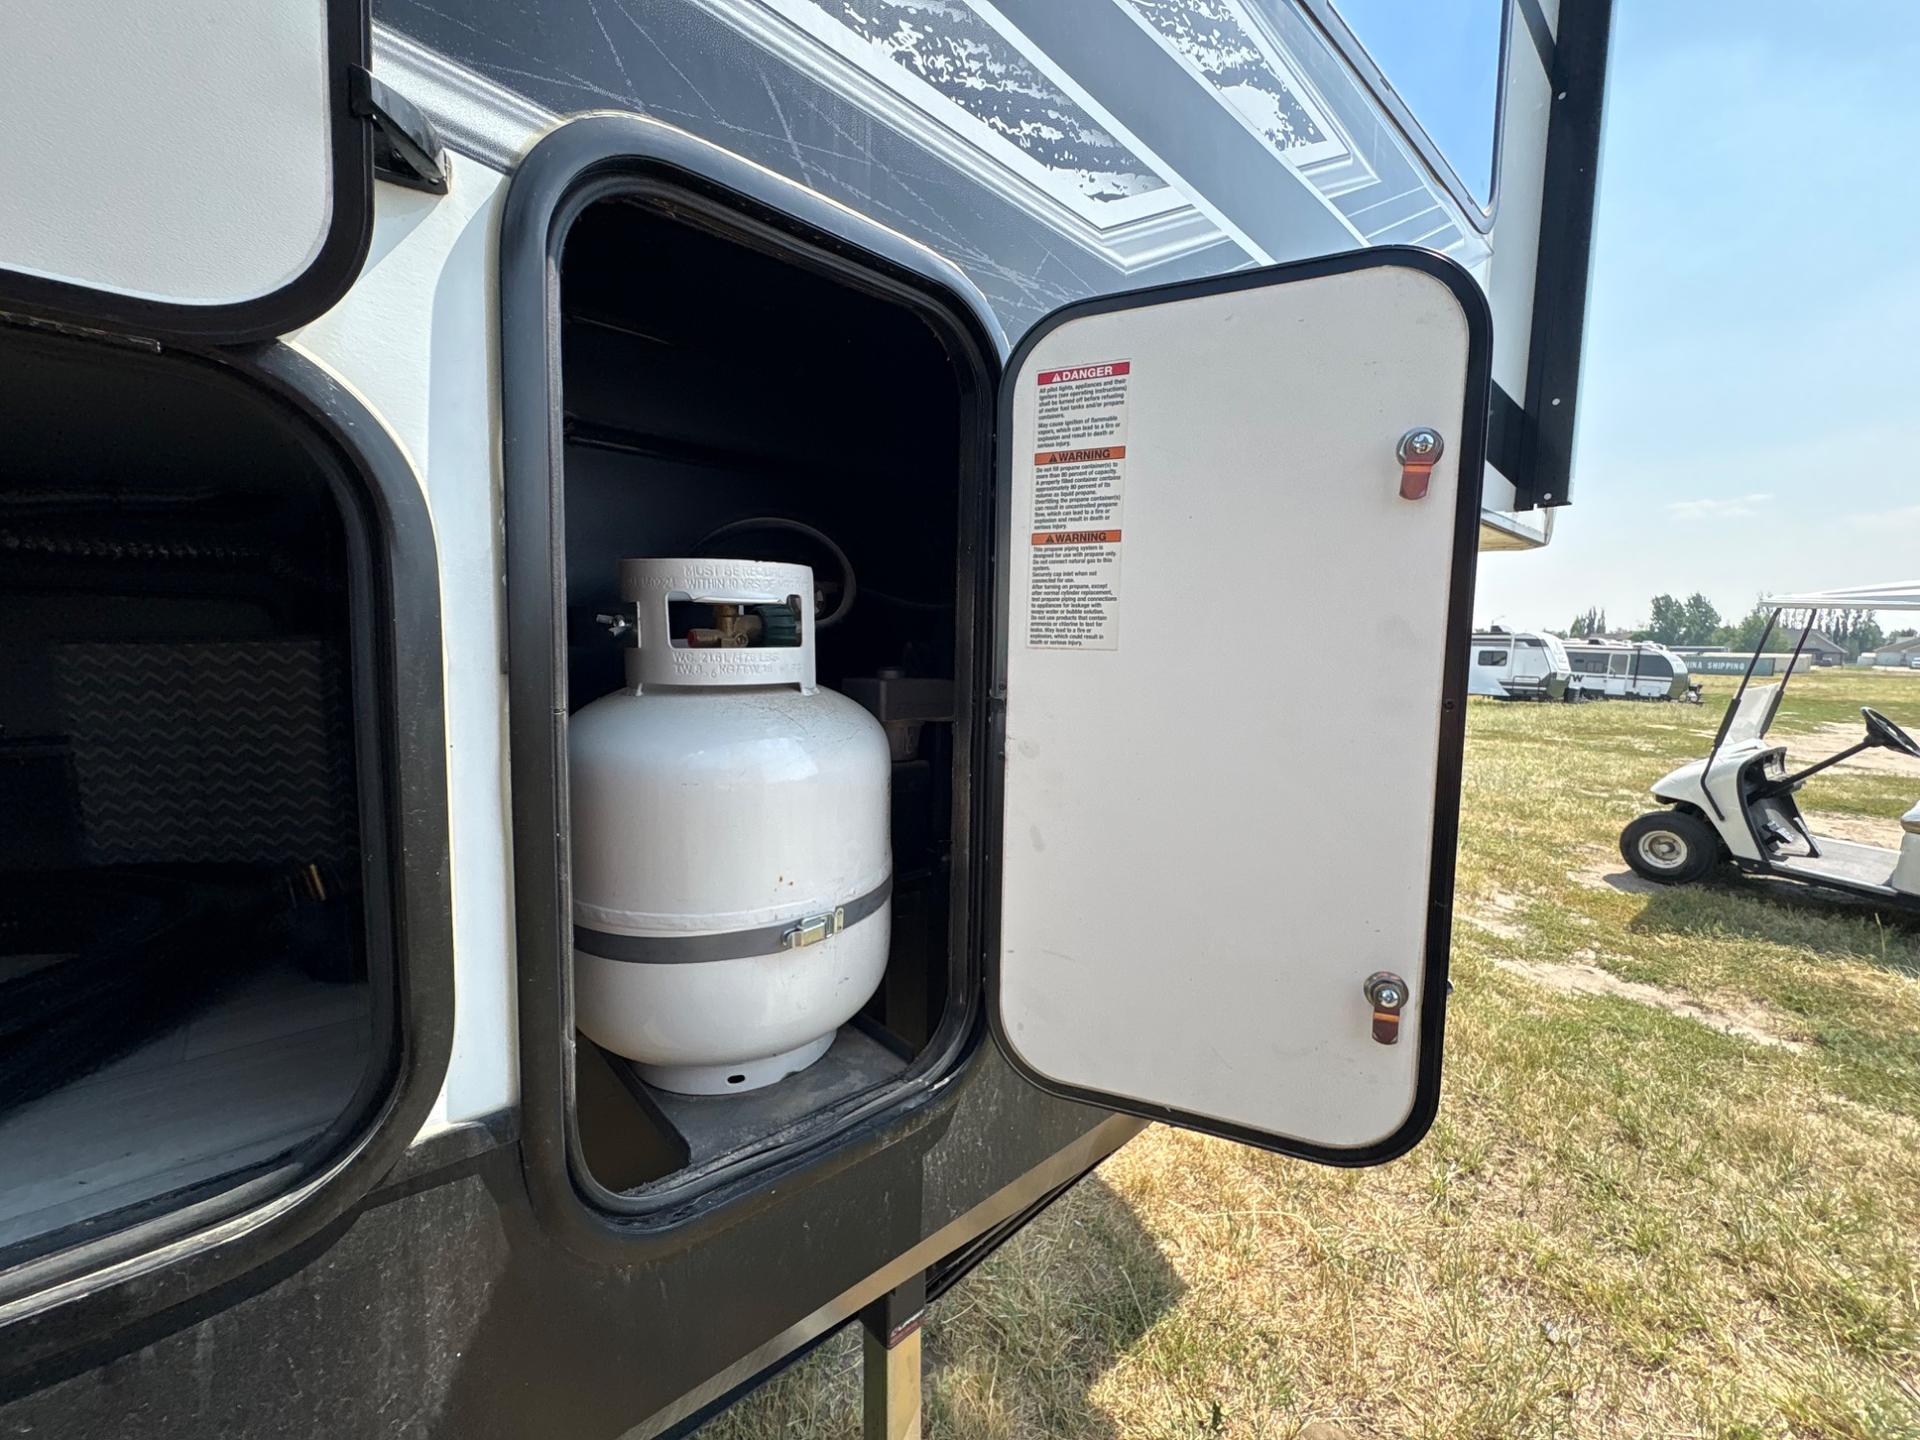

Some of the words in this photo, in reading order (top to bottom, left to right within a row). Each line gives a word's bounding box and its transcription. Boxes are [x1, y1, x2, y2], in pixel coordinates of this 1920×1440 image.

[1062, 365, 1112, 381] DANGER
[1058, 448, 1110, 461] WARNING
[1054, 532, 1106, 542] WARNING
[1707, 661, 1744, 670] SHIPPING
